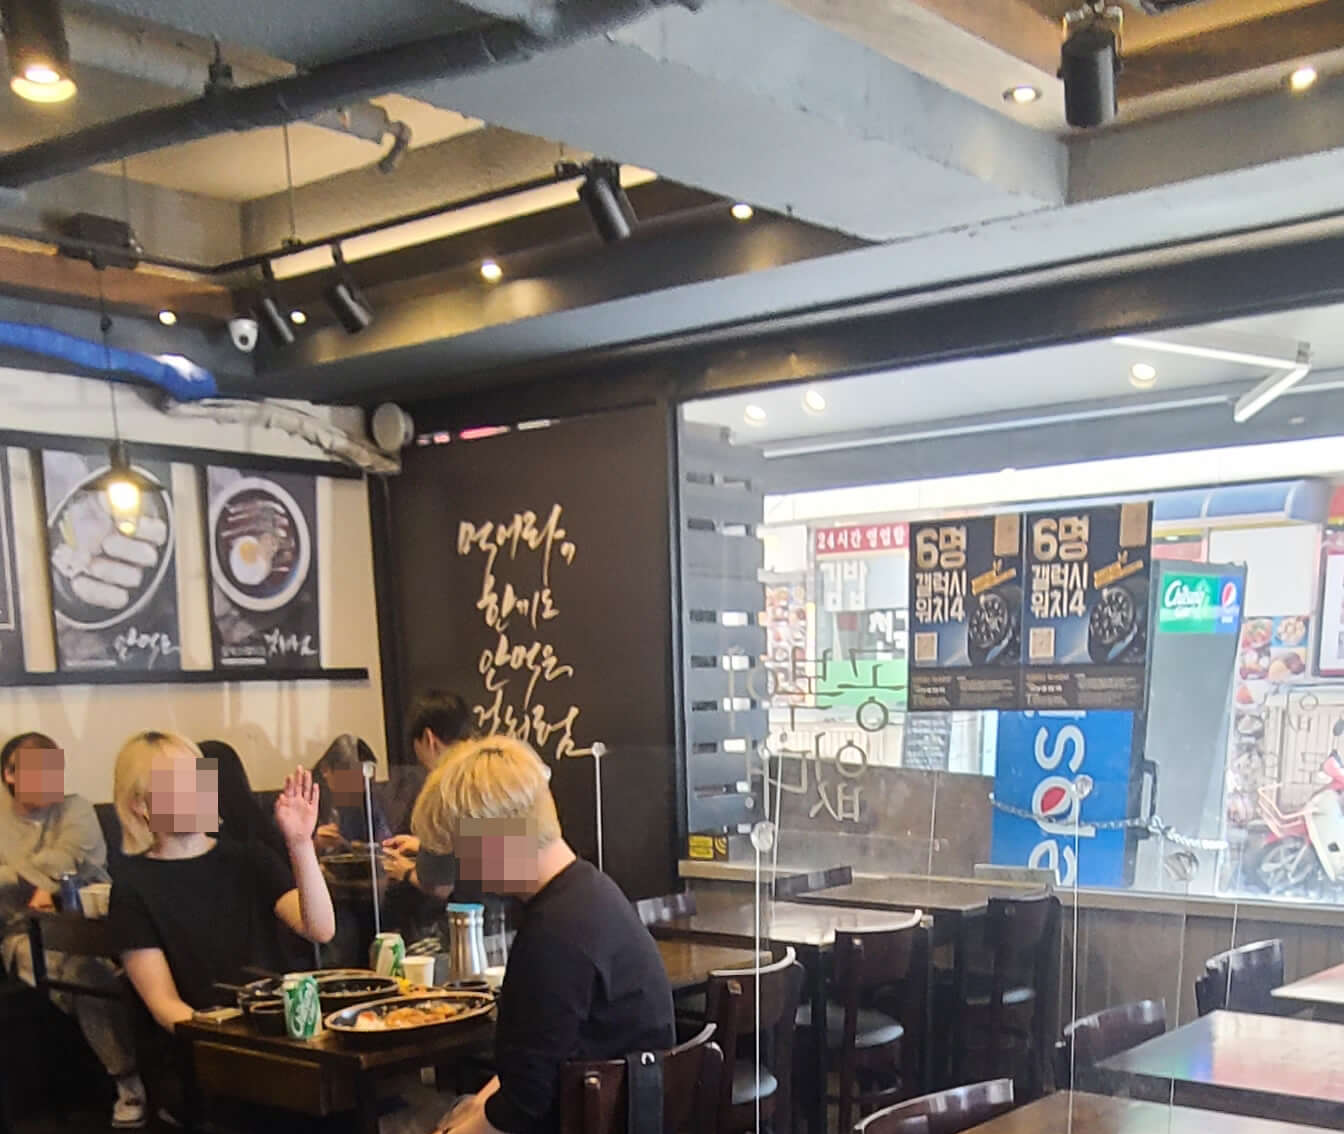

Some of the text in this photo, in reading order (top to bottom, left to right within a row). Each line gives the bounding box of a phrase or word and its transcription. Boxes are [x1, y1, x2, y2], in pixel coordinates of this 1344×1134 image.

[916, 526, 967, 569] 6명
[1033, 514, 1089, 562] 6명
[915, 570, 967, 597] 갤럭시
[1031, 560, 1089, 592] 갤럭시
[915, 596, 967, 624] 워치4
[1031, 589, 1087, 619] 워치4
